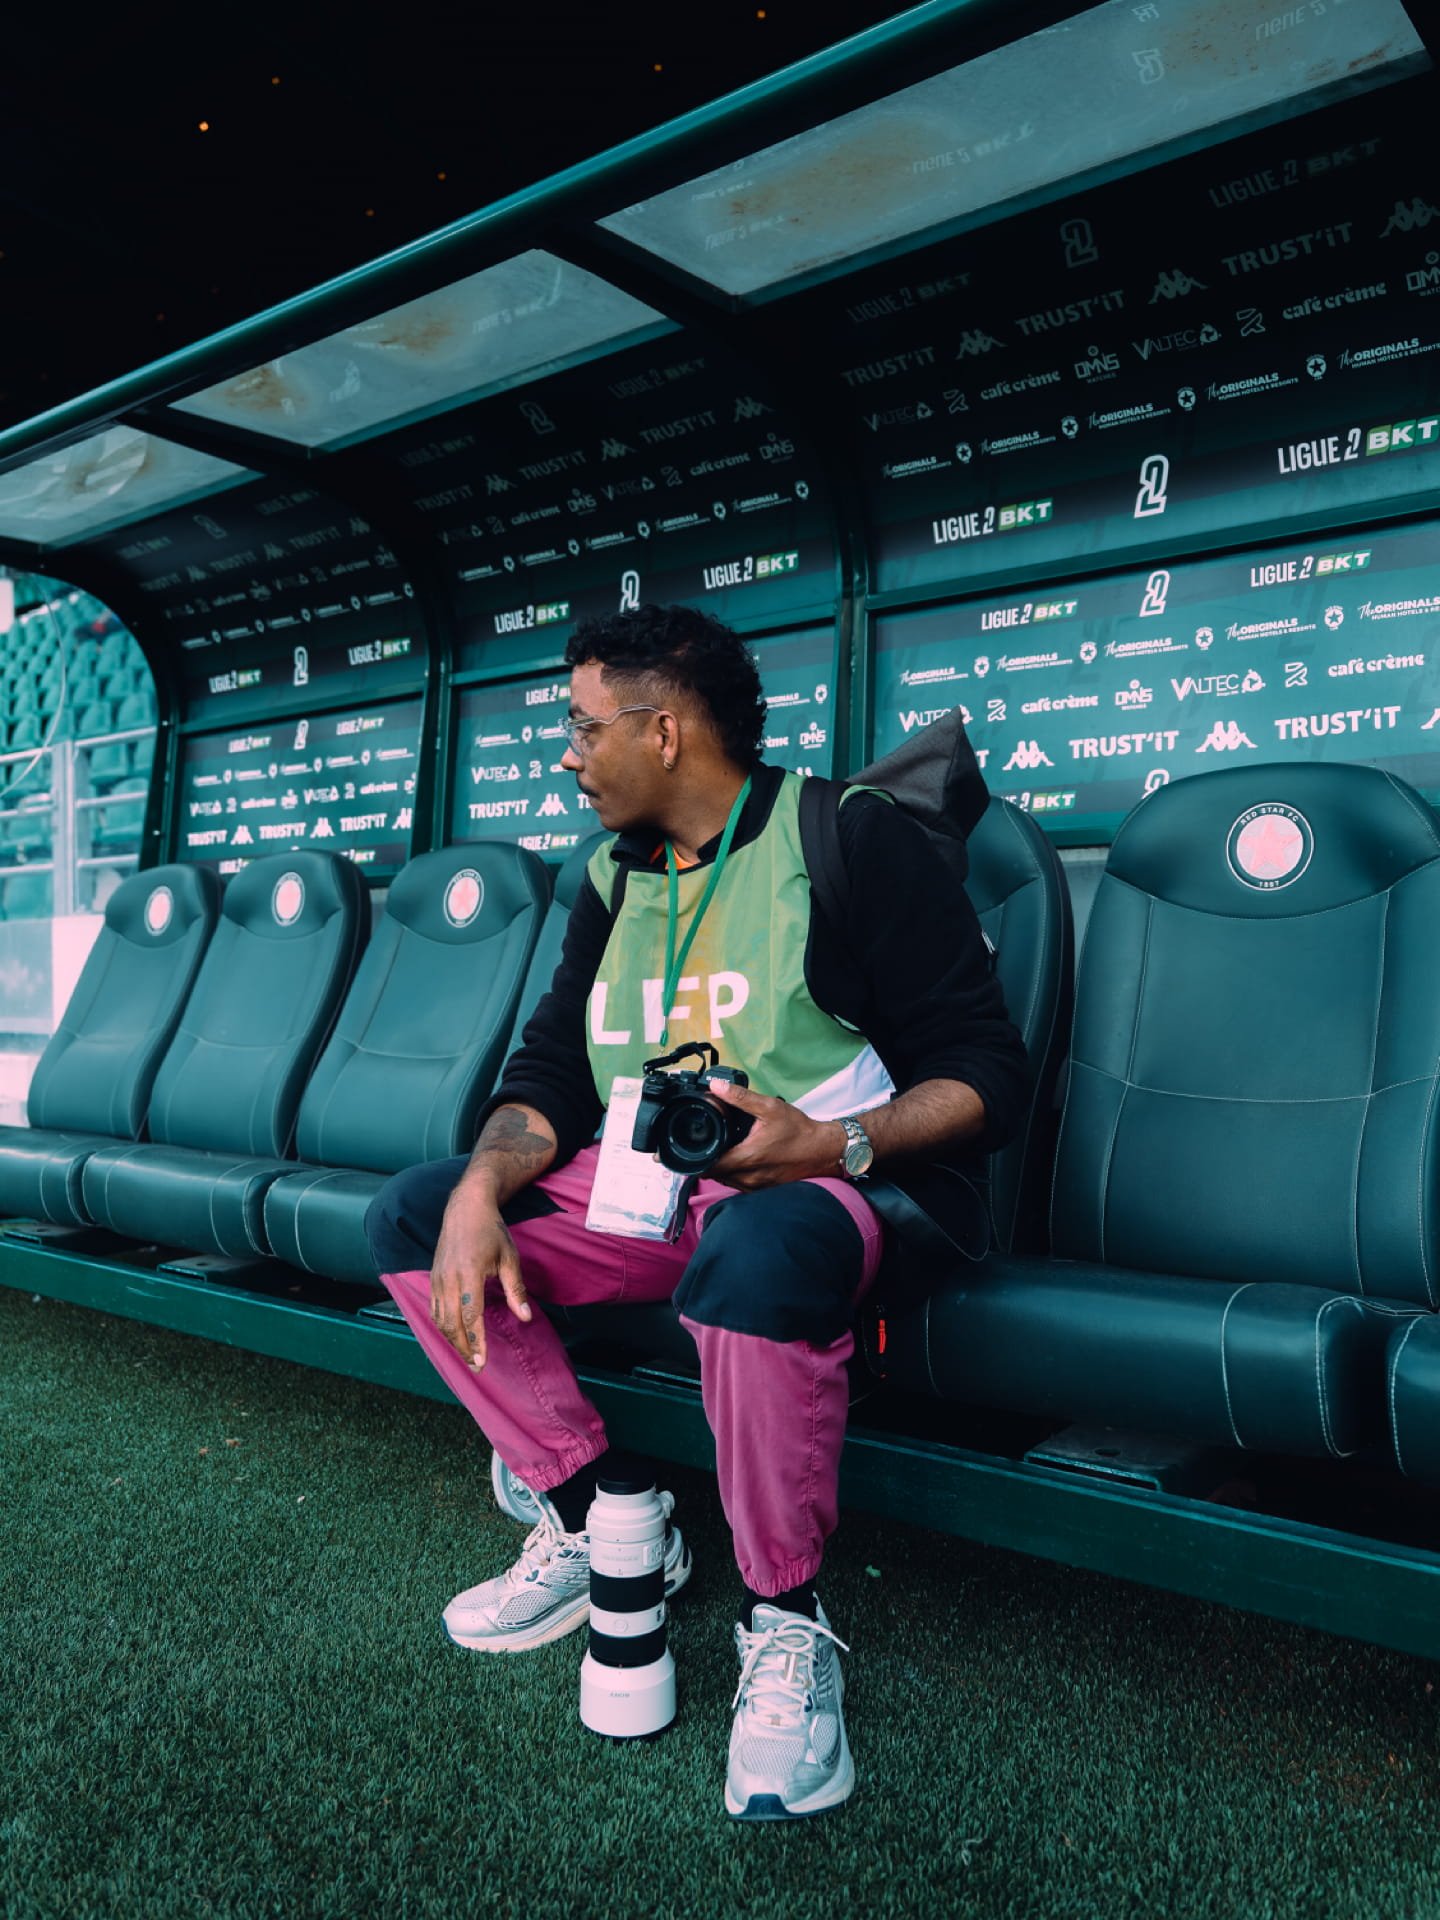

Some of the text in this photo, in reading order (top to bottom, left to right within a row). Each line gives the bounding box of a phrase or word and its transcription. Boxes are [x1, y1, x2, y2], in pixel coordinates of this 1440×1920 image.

[1282, 296, 1323, 320] café
[1324, 281, 1388, 309] crème
[1353, 337, 1420, 361] ORIGINALS
[1219, 372, 1279, 394] ORIGINALS
[1278, 420, 1438, 474] LIGUE 2 BKT
[932, 501, 1052, 544] LIGUE 2 BKT
[703, 552, 798, 590] LIGUE 2 BKT
[1250, 552, 1370, 588] LIGUE 2 BKT
[494, 603, 569, 634] LIGUE 2 BKT
[981, 601, 1077, 631] LIGUE 2 BKT
[1375, 596, 1440, 614] ORIGINALS
[1240, 618, 1298, 634] ORIGINALS
[1171, 654, 1425, 701] VALTEC café crème
[1021, 697, 1051, 714] café
[1052, 695, 1099, 711] crème
[1033, 793, 1076, 810] BKT
[590, 971, 750, 1045] LFP
